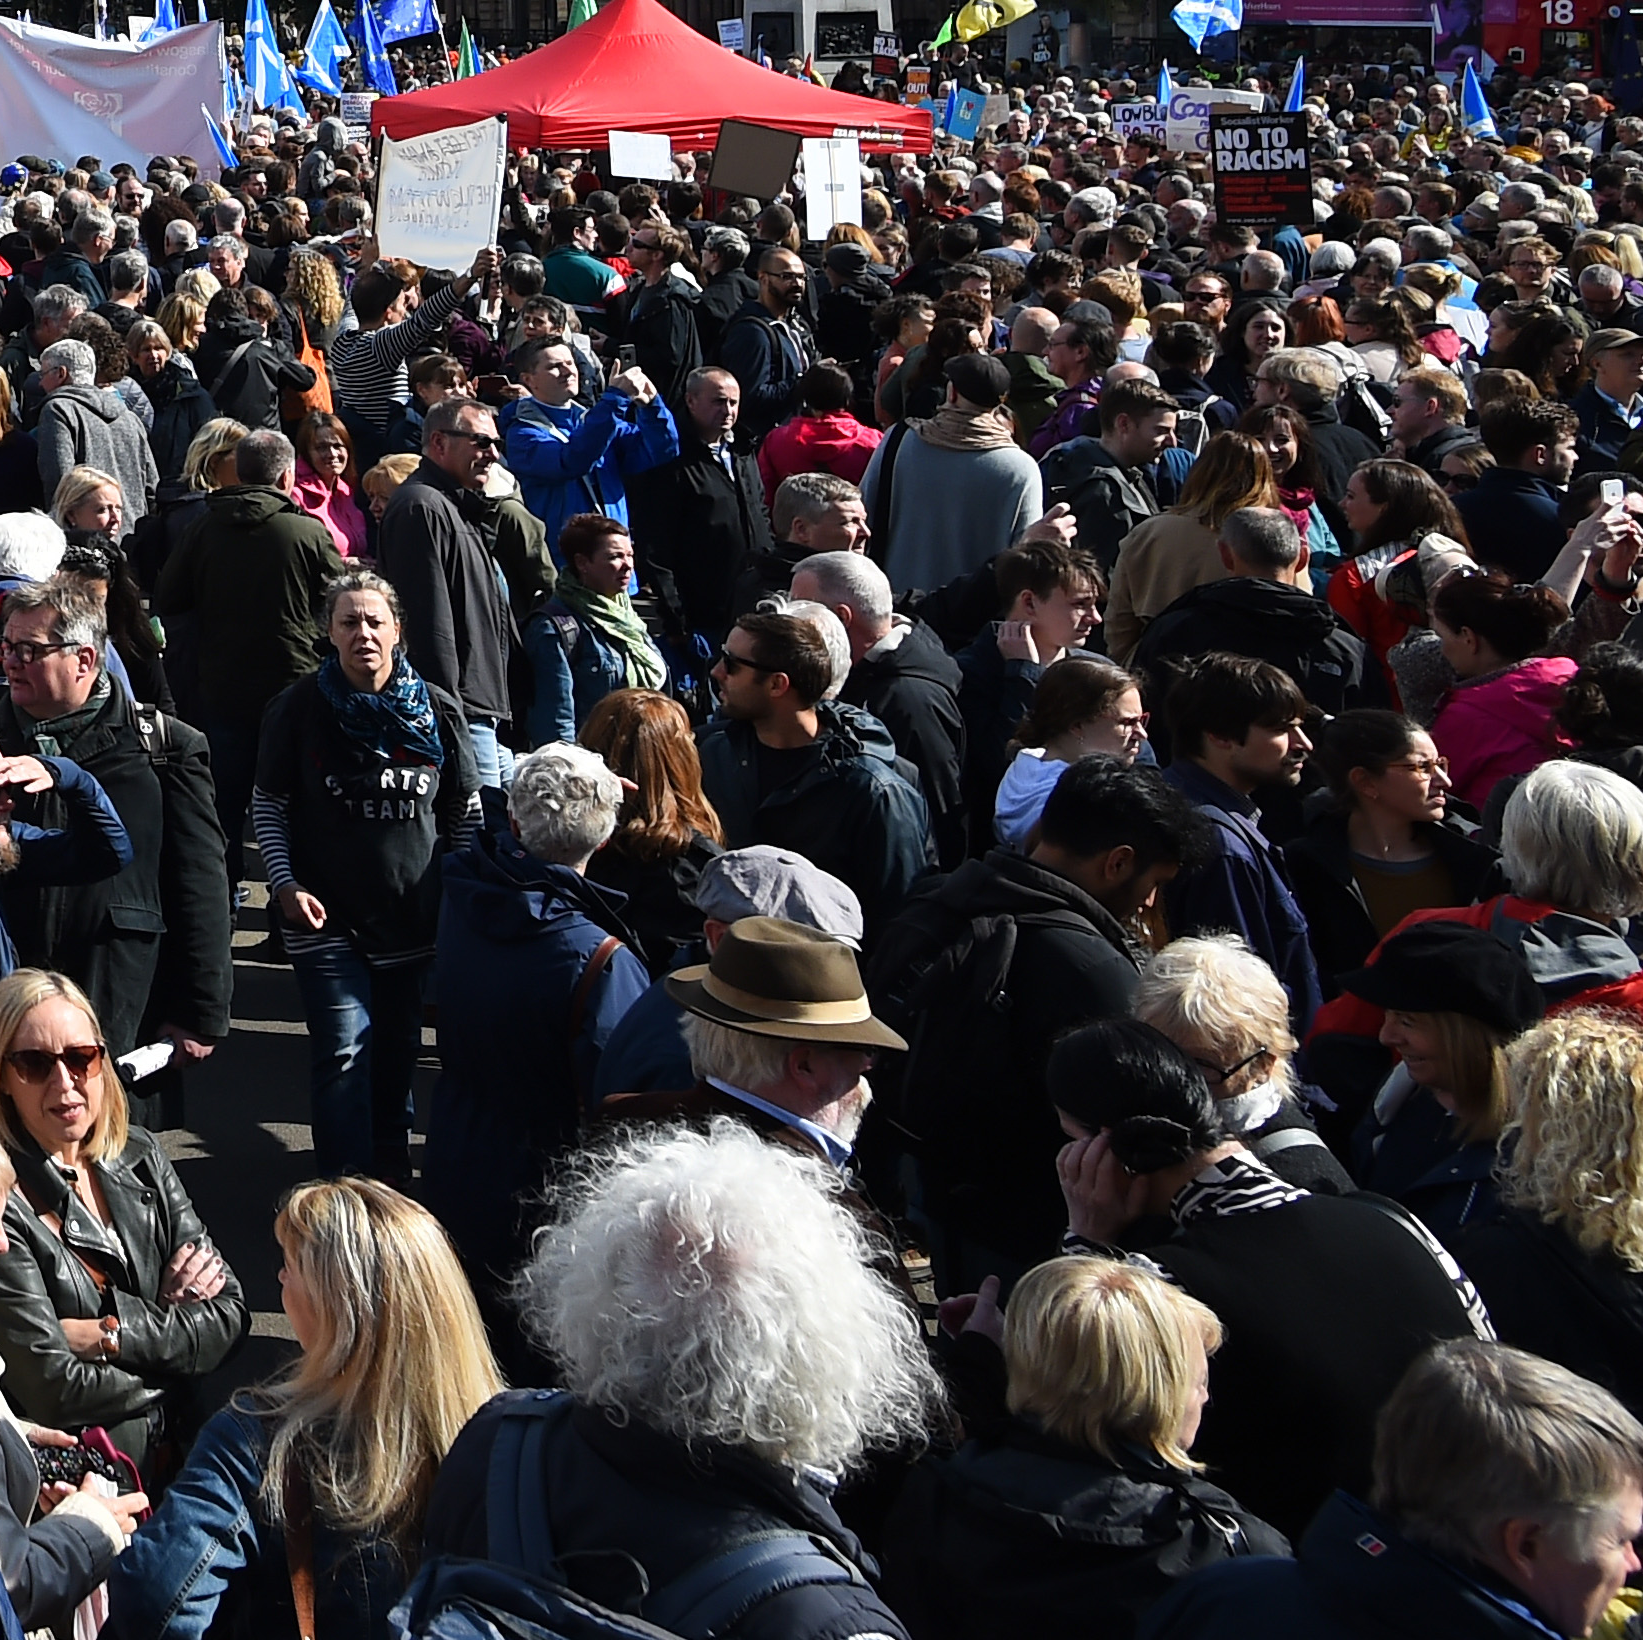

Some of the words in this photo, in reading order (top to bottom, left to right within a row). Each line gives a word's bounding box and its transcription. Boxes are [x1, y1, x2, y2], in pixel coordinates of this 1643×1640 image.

[874, 35, 885, 45] NO
[887, 37, 896, 46] TO
[873, 46, 899, 57] RACISM
[907, 82, 928, 94] OUT!
[1214, 128, 1250, 150] NO
[1257, 127, 1289, 149] TO
[1216, 148, 1307, 172] RACISM
[325, 767, 431, 796] SRTS
[345, 799, 415, 820] TEAM
